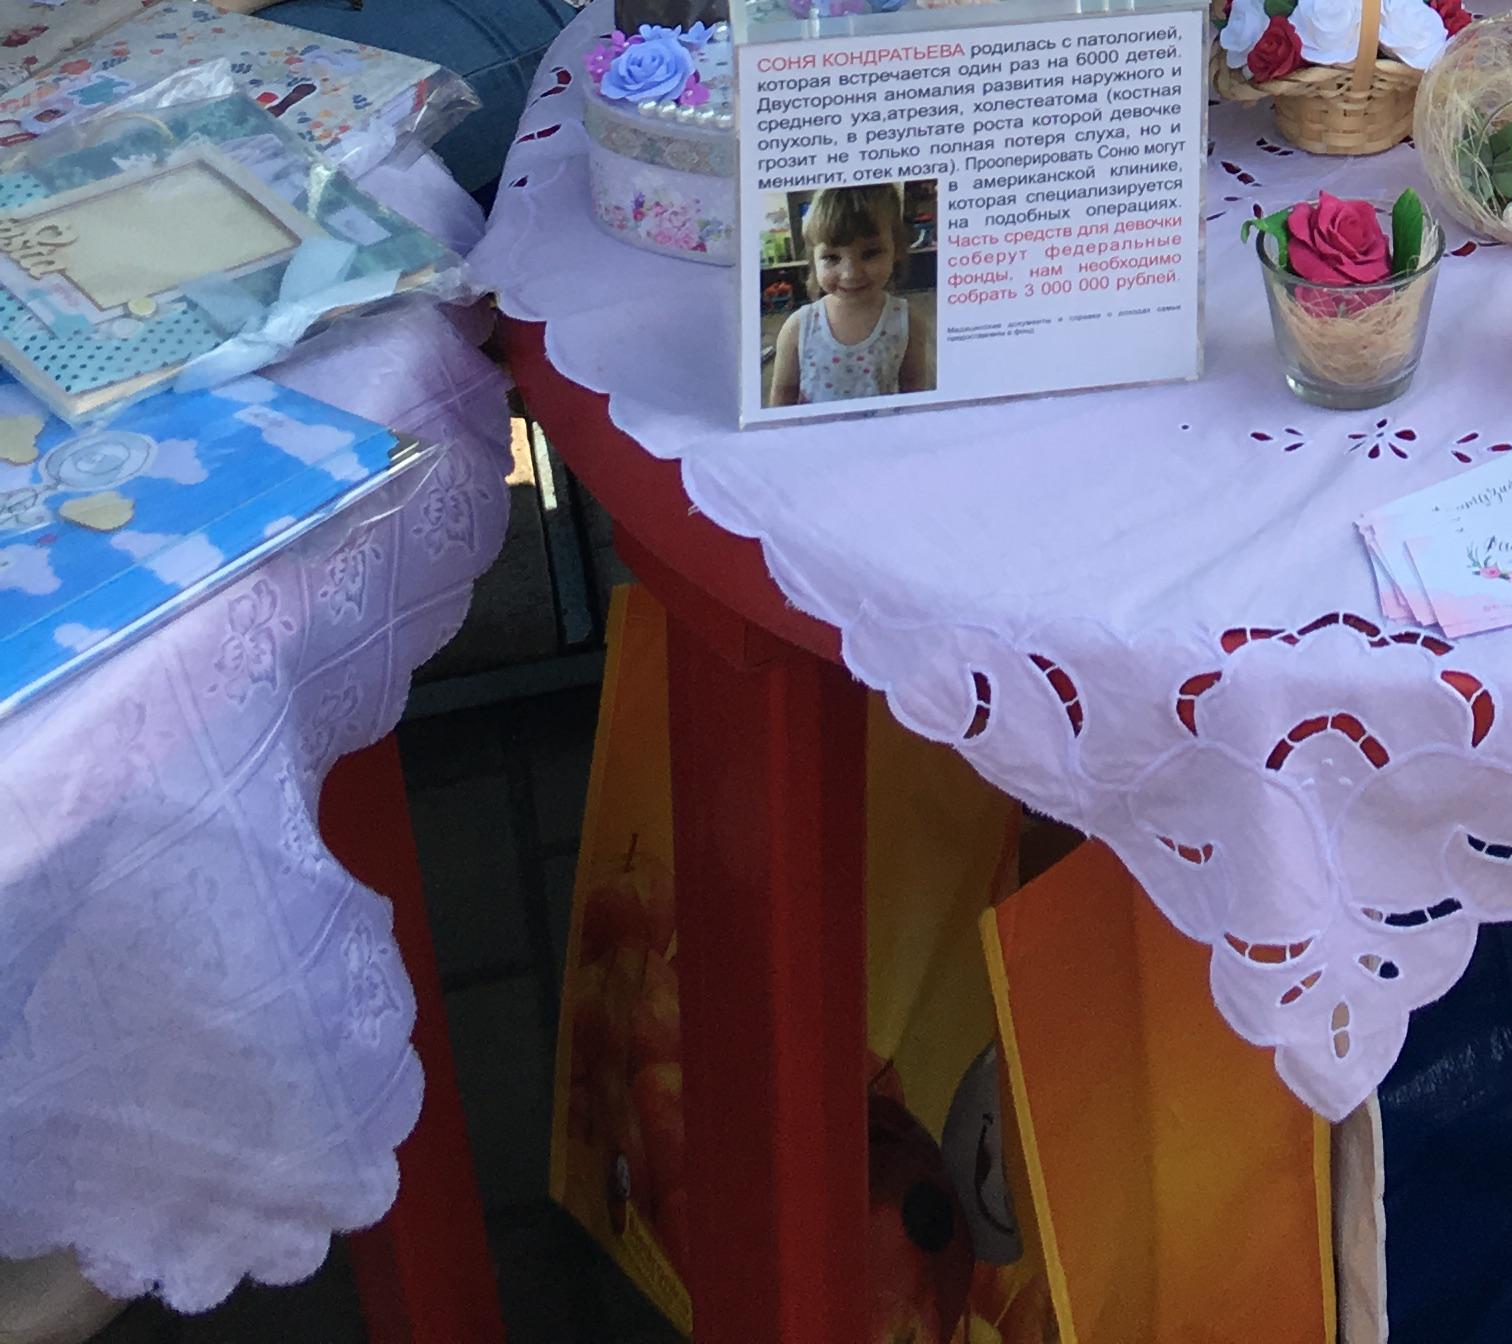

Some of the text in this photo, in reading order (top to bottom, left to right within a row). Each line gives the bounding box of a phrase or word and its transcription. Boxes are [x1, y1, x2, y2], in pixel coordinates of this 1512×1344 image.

[757, 26, 1182, 73] СОНЯ КОНДРАТЬЕВА родилась с патологией,
[757, 46, 1181, 93] которая встречается один раз на 6000 детей.
[757, 67, 1182, 114] Двустороння аномалия развития наружного и
[758, 114, 842, 133] среднего
[973, 91, 1098, 113] холестеатома
[1107, 84, 1182, 104] (костная
[758, 103, 1181, 154] опухоль, в результате роста которой девочке
[758, 123, 1181, 172] грозит не только полная потеря слуха, но и
[758, 140, 1186, 189] менингит, отек мозга). Прооперировать Соню могут
[949, 161, 1182, 192] в американской клинике,
[949, 178, 1183, 210] которая специализируется
[949, 198, 1182, 229] на подобных операциях.
[948, 234, 1182, 268] соберут федеральные
[949, 215, 1182, 248] Часть средств для девочки
[1029, 264, 1063, 277] нам
[1079, 253, 1182, 273] необходимо
[947, 269, 1181, 305] собрать 3 000 000 рублей.
